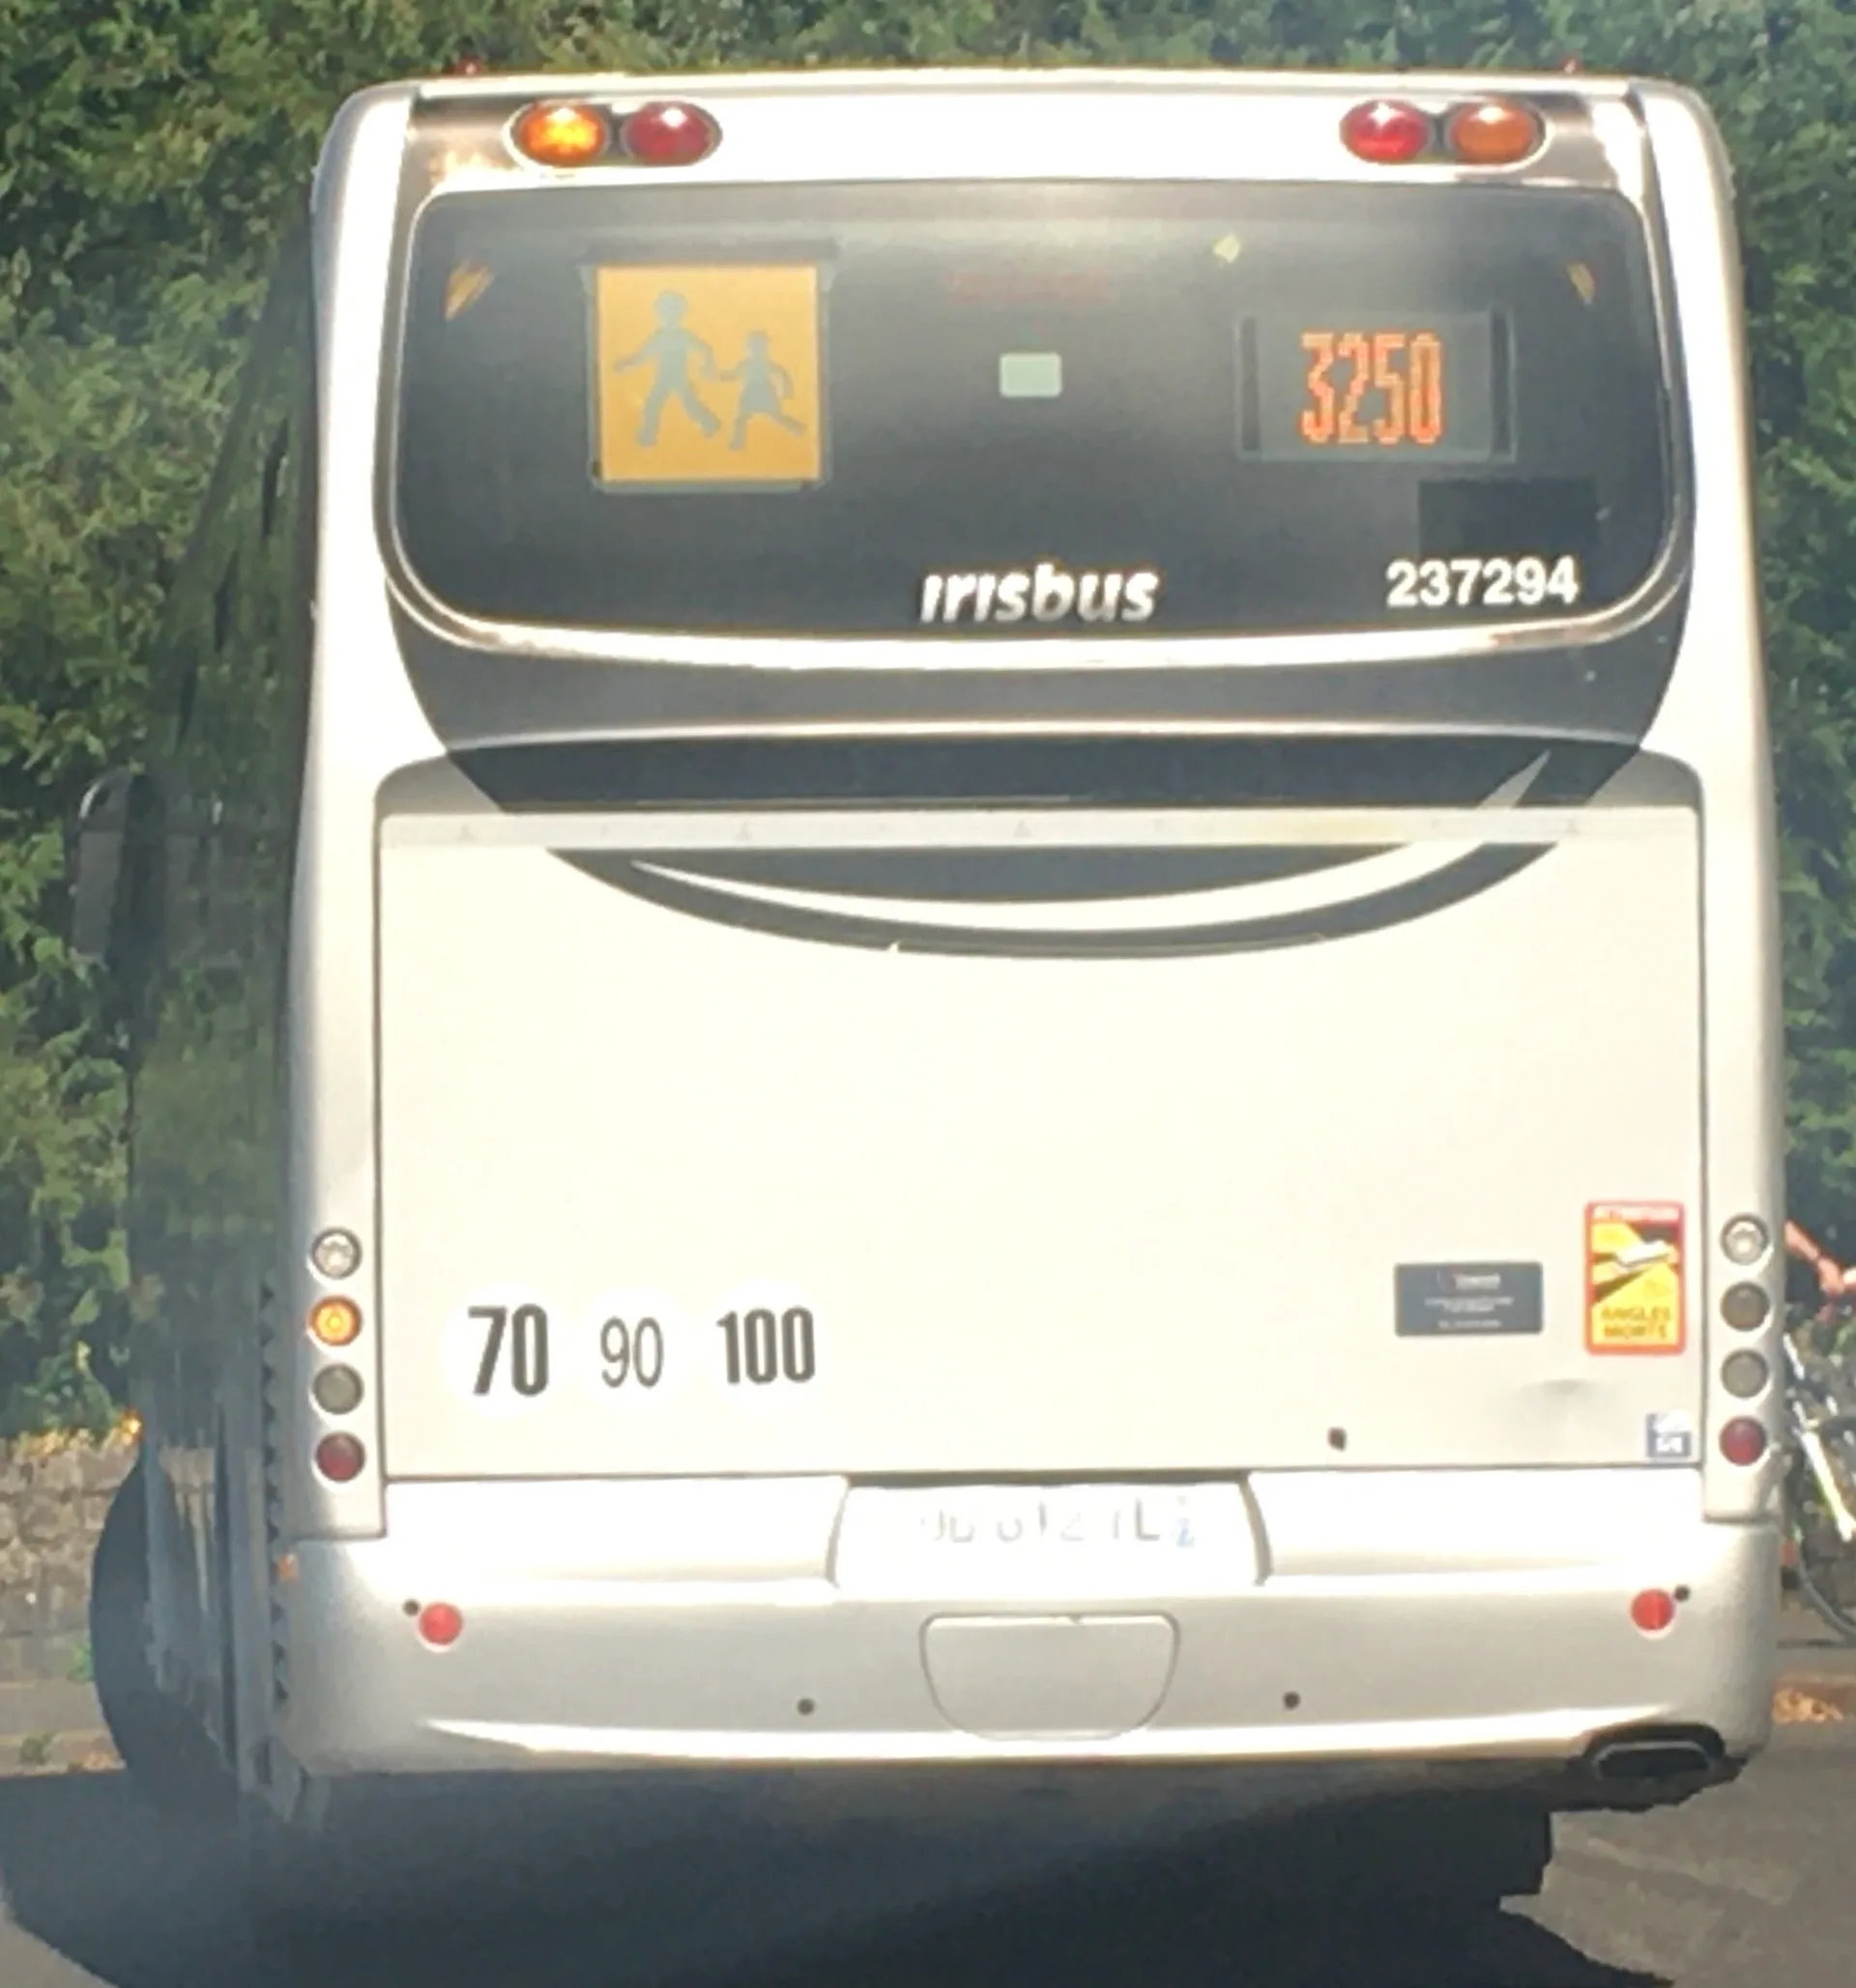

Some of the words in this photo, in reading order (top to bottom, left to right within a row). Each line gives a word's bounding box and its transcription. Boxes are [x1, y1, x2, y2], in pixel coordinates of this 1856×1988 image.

[1299, 330, 1443, 446] 3250
[919, 562, 1159, 624] irisbus
[1385, 555, 1580, 609] 237294
[467, 1302, 550, 1397] 70
[599, 1315, 665, 1389] 90
[716, 1305, 816, 1386] 100
